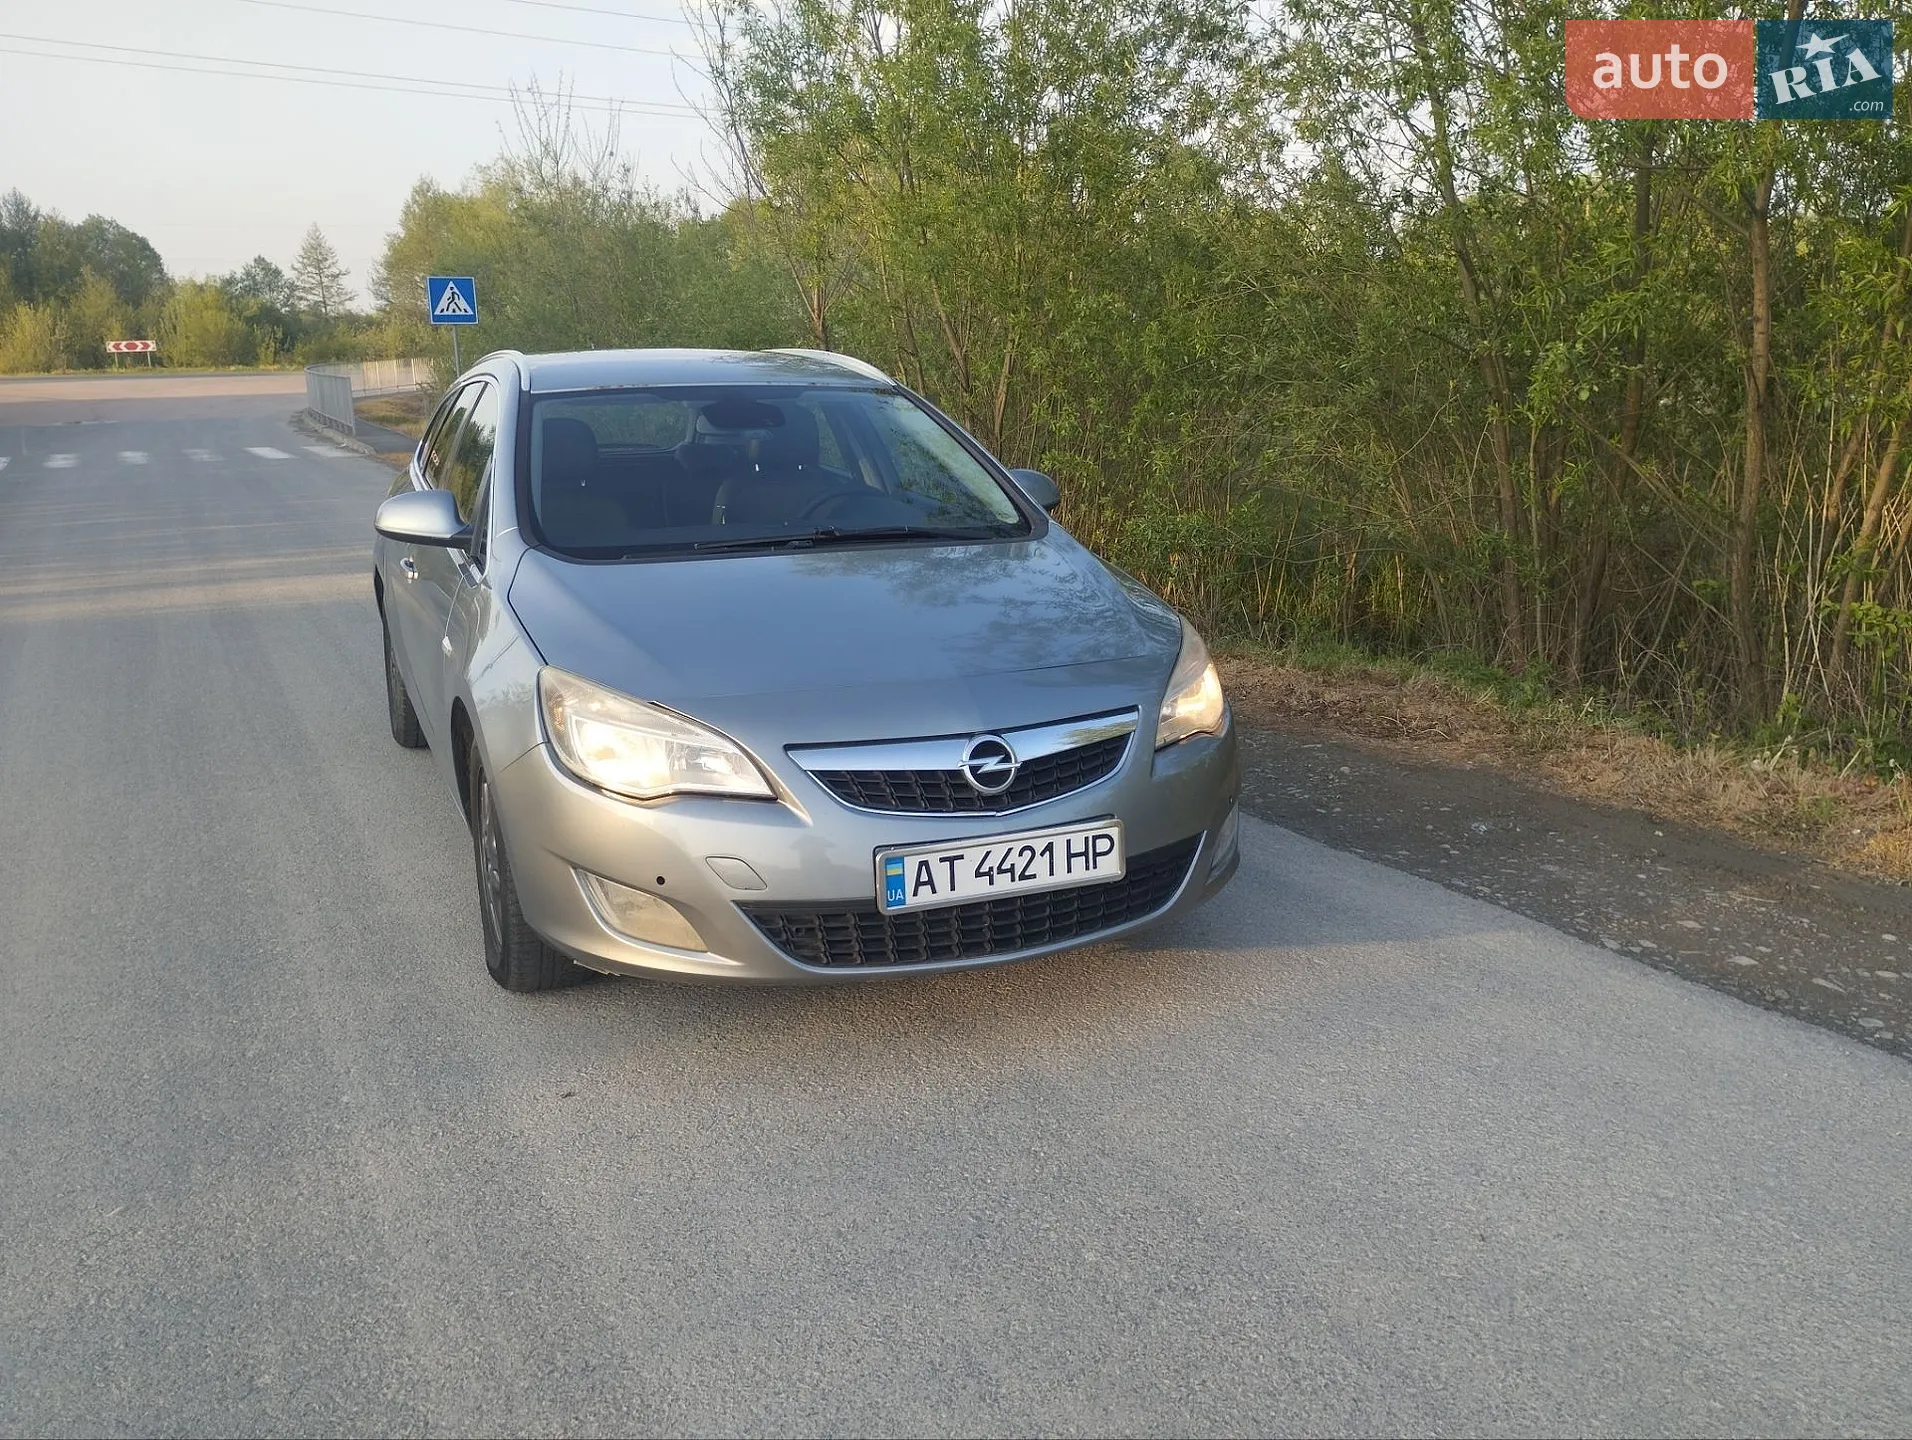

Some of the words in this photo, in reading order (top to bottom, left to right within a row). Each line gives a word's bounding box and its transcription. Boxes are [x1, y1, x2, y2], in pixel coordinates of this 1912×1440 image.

[912, 853, 965, 897] AT
[974, 841, 1055, 886] 4421
[1066, 833, 1116, 874] HP
[886, 889, 905, 902] UA
